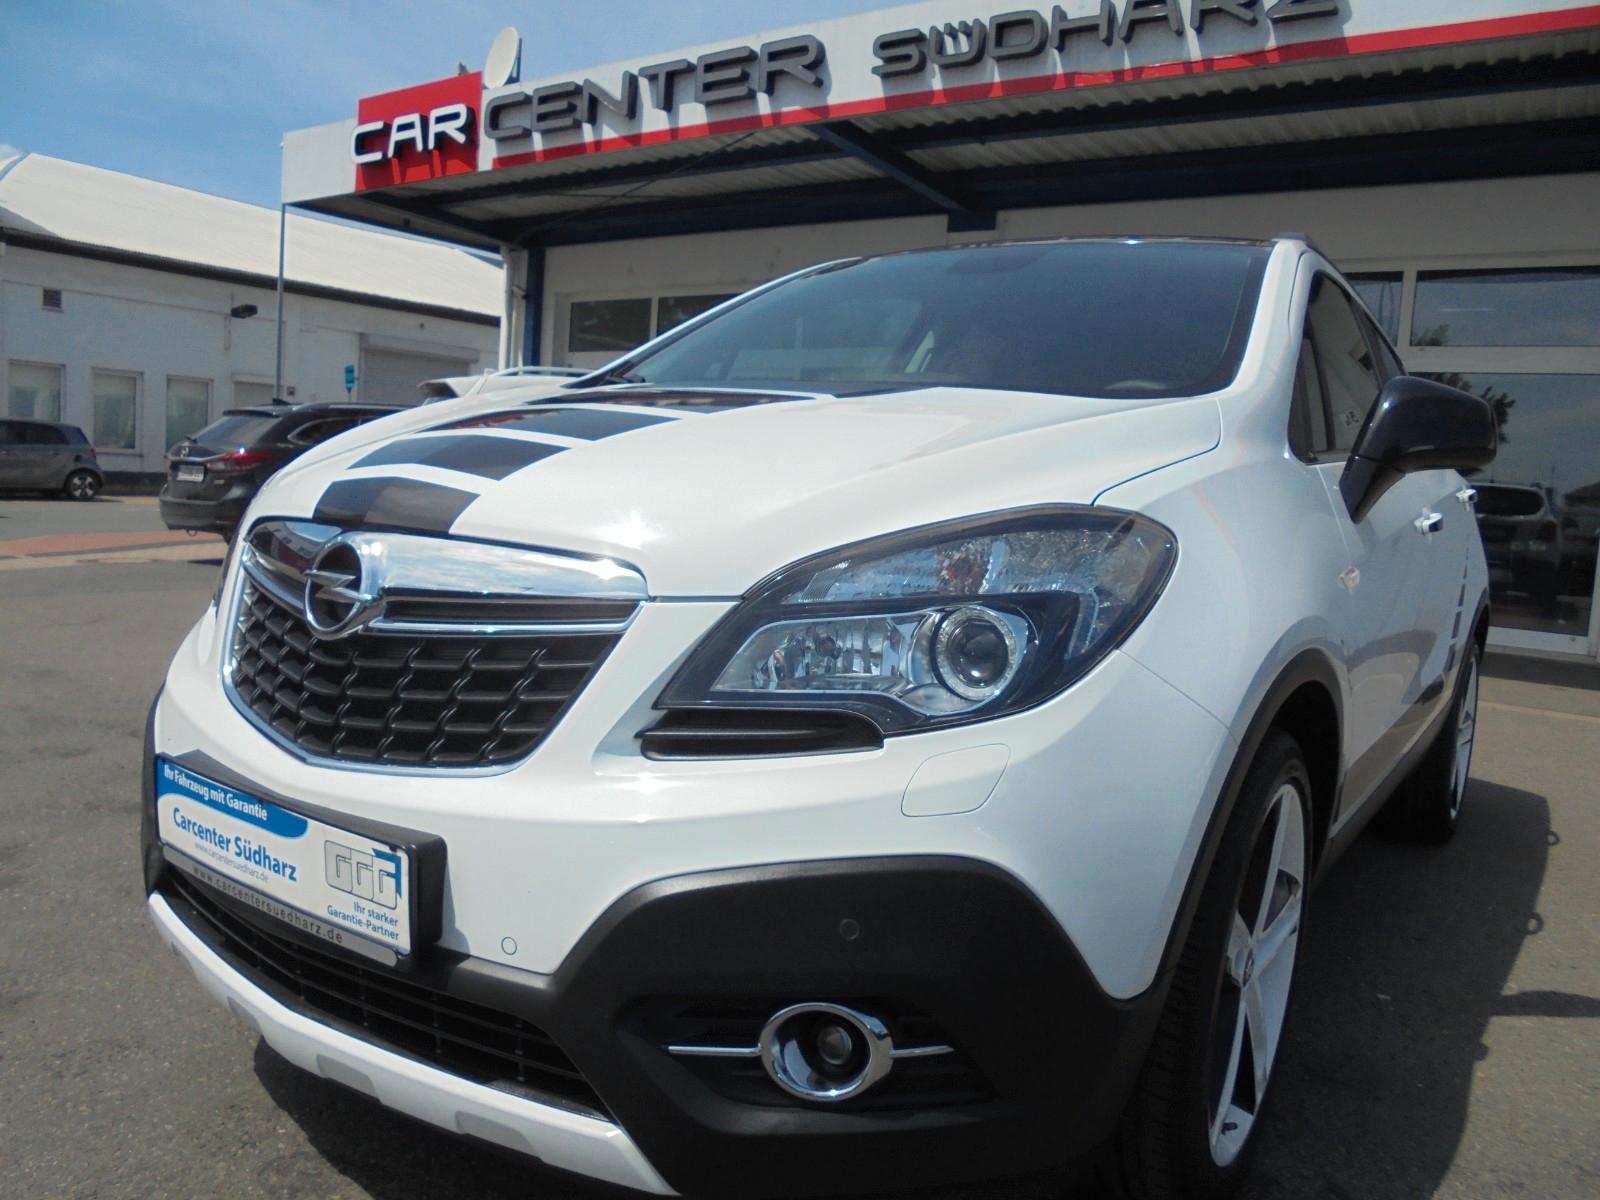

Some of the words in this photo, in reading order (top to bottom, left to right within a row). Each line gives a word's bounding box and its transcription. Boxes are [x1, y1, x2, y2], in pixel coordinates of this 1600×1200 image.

[351, 103, 477, 165] CAR
[484, 34, 826, 141] CENTER
[164, 764, 175, 781] Ihr
[174, 769, 210, 801] Fahrzeug
[210, 788, 225, 805] mit
[226, 793, 268, 821] Garantie
[173, 807, 231, 853] Carcenter
[233, 835, 297, 882] Südharz
[193, 866, 343, 944] www.carcentersuedharz.de
[327, 904, 400, 941] Garantie-Partner
[353, 901, 366, 913] Ihr
[367, 907, 399, 928] starker
